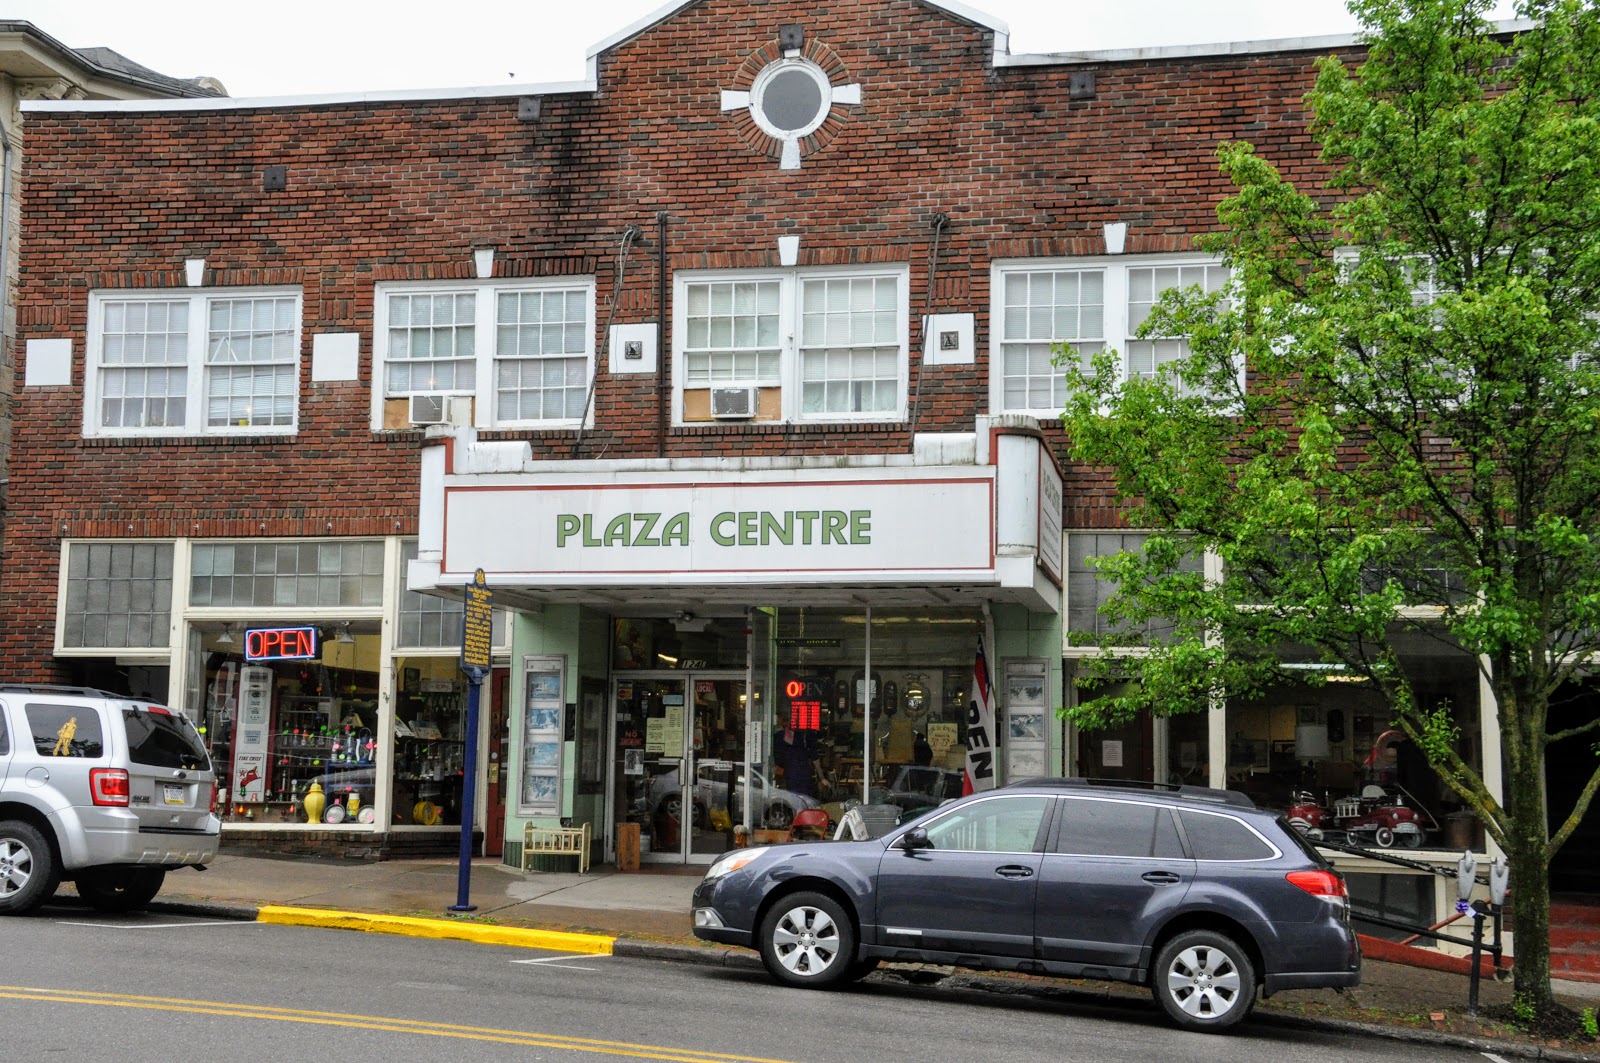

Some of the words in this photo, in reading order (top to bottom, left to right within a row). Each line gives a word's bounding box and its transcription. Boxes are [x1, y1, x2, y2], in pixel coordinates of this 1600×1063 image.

[556, 512, 690, 547] PLAZA
[709, 509, 871, 547] CENTRE
[248, 631, 314, 657] OPEN
[786, 681, 823, 698] OPEN
[968, 700, 993, 779] PEN
